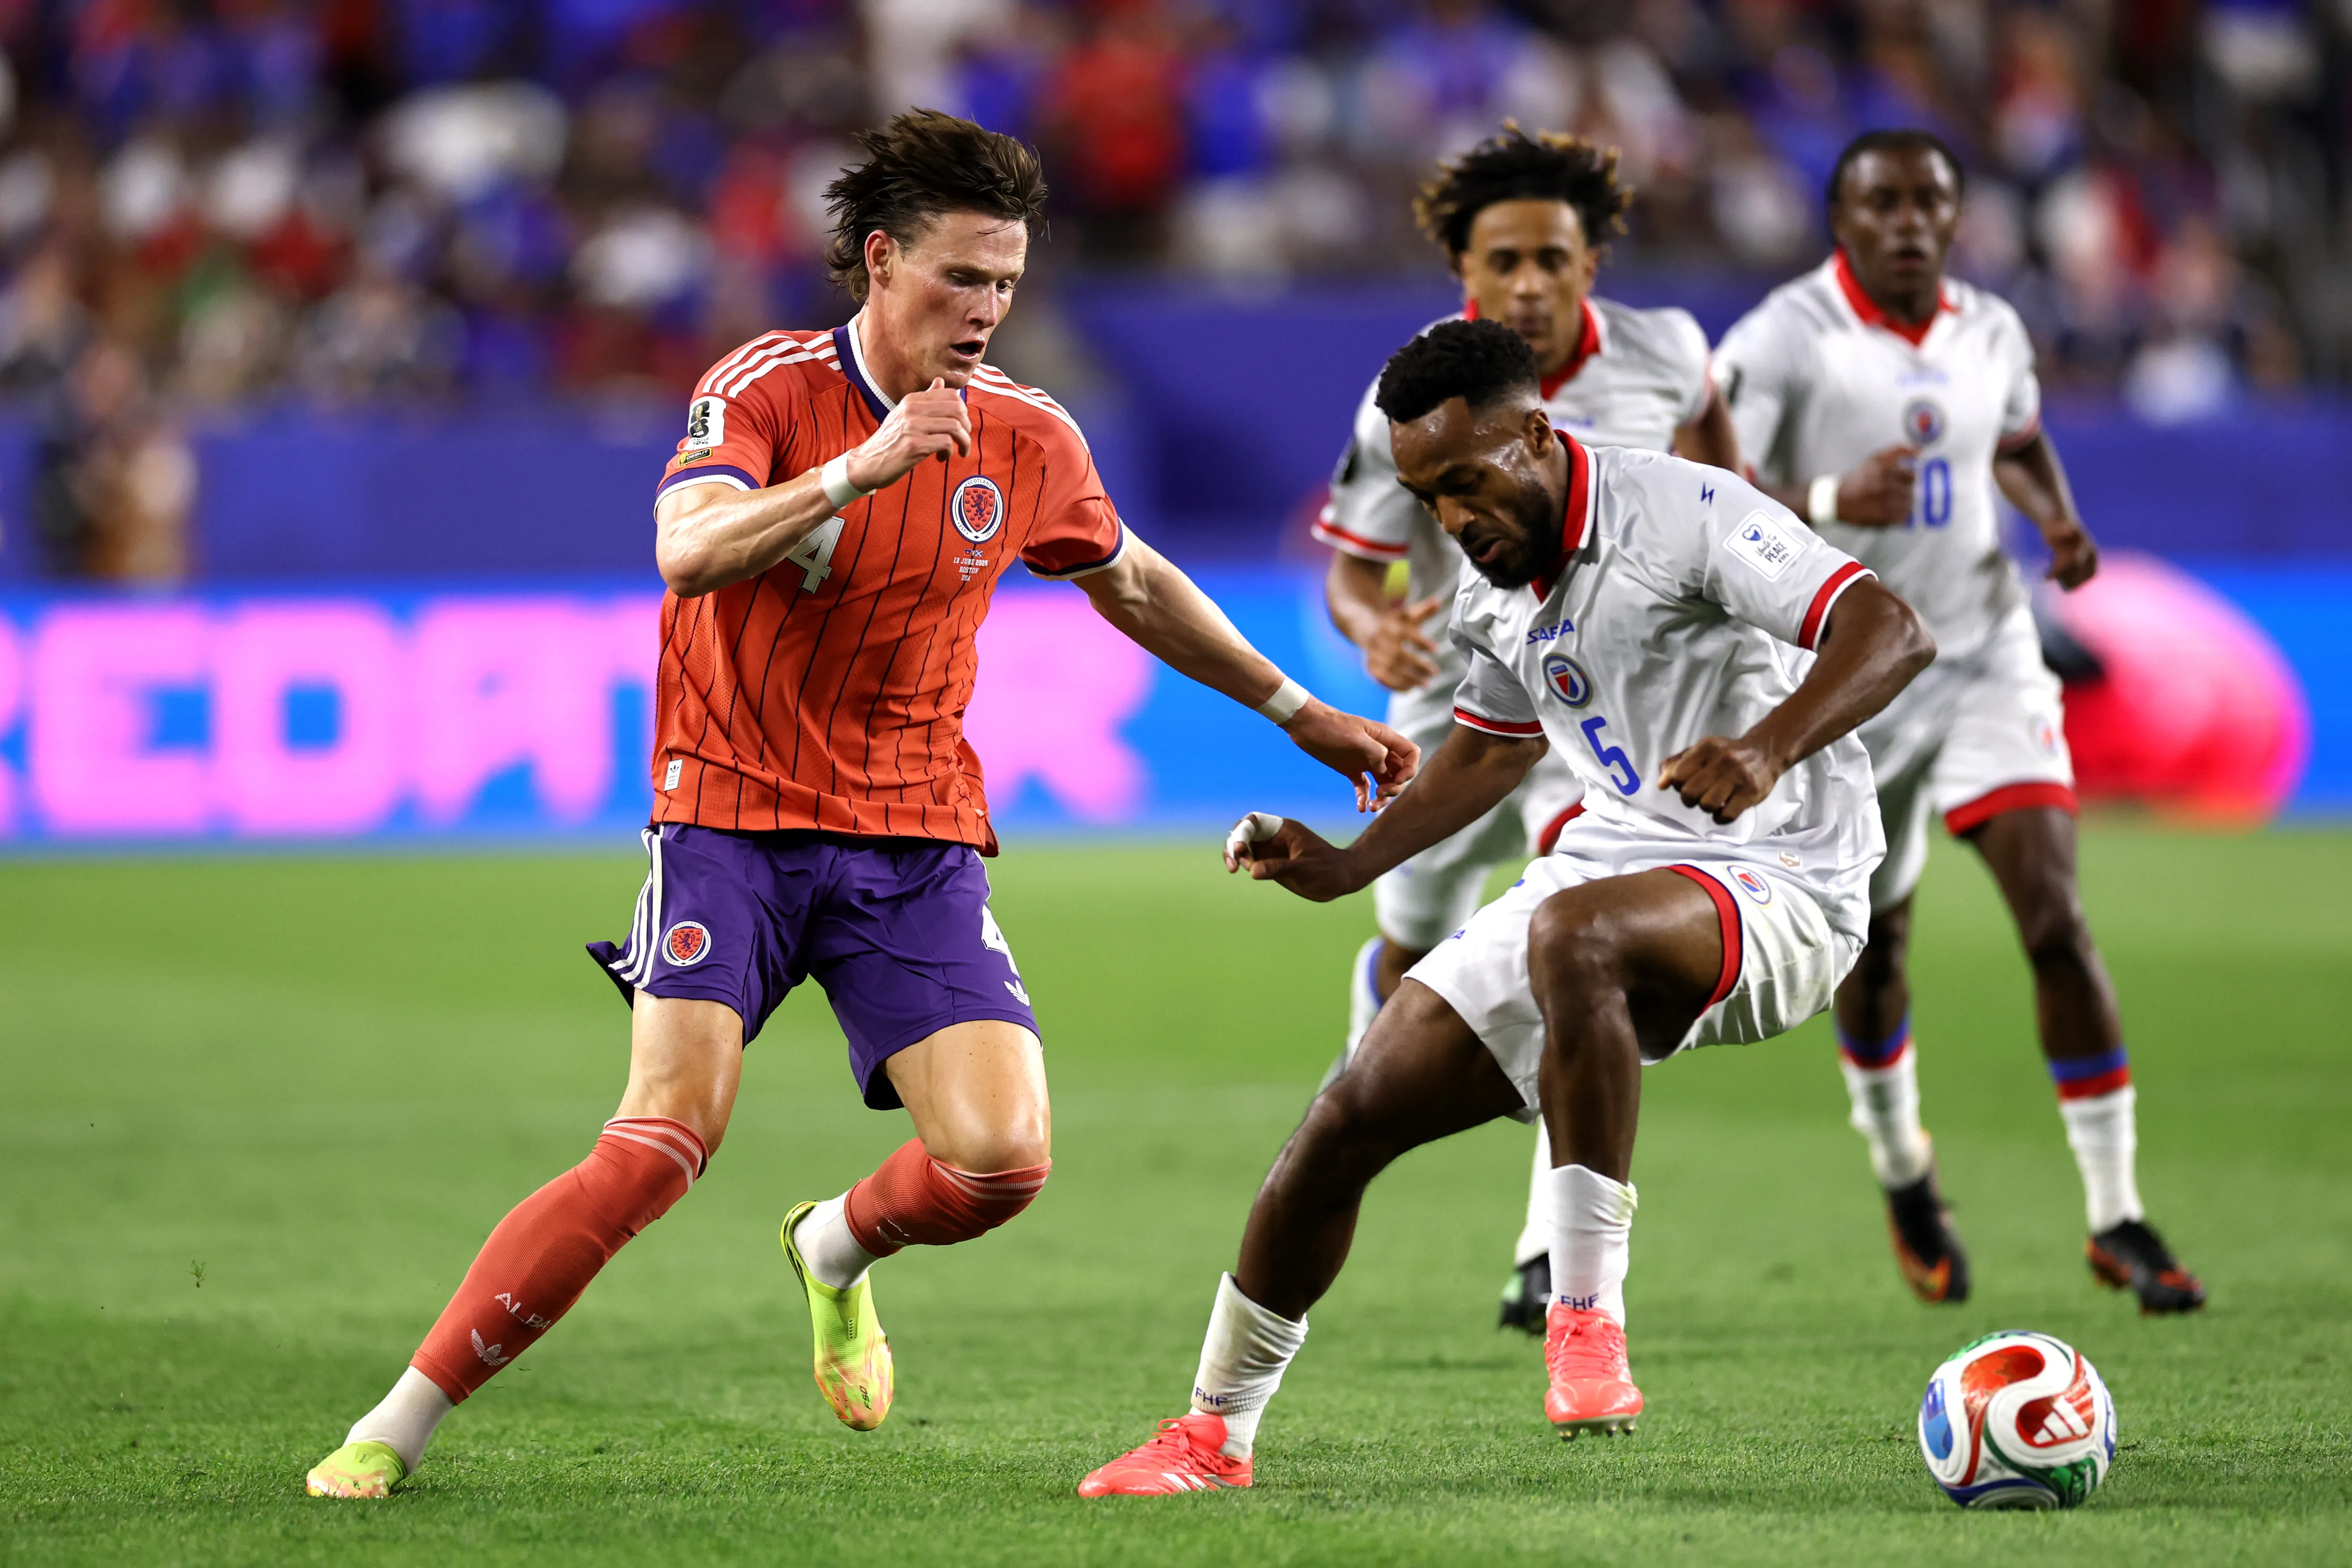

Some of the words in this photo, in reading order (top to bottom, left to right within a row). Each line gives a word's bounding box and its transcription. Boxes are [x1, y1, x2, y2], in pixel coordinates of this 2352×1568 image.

[687, 450, 709, 460] DEBUT
[968, 479, 992, 488] SCOTLAND
[987, 528, 995, 536] 1873
[785, 515, 845, 595] 4
[1765, 541, 1787, 563] PEACE
[959, 566, 980, 574] BOSTON
[1581, 716, 1640, 795] 5
[1561, 1293, 1599, 1310] FHF
[1195, 1387, 1228, 1407] FHF
